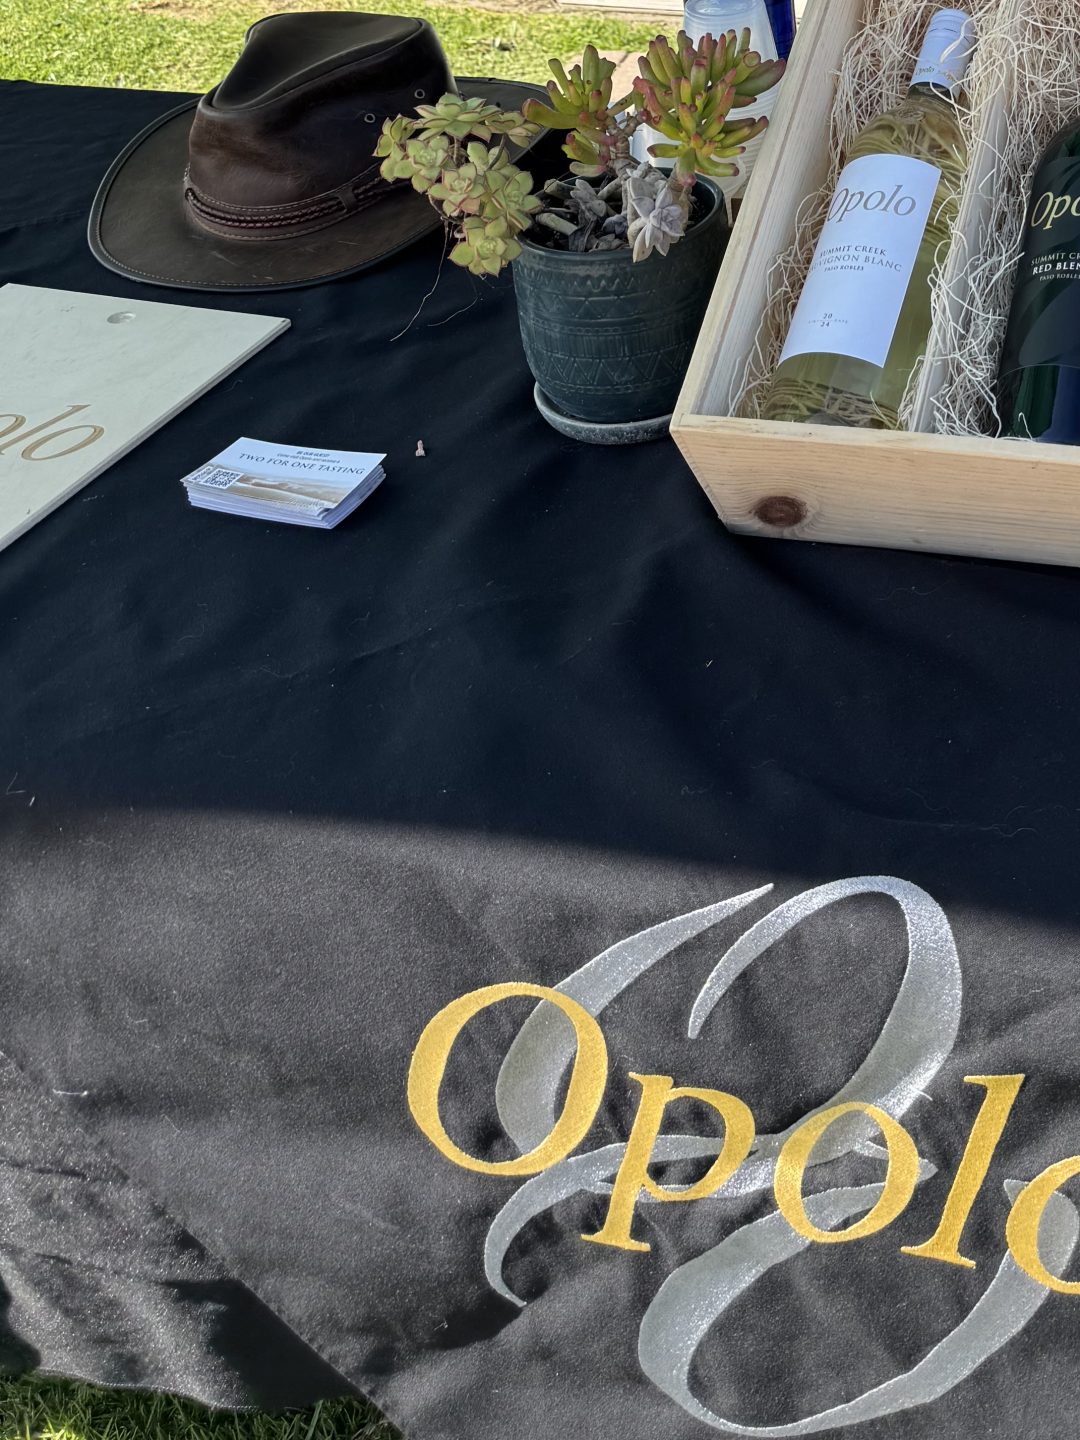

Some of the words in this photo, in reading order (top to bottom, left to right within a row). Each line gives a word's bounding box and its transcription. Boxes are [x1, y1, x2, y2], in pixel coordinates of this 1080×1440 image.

[826, 184, 917, 224] Opolo
[820, 245, 852, 258] SUMMIT
[854, 245, 887, 257] CREEK
[1031, 252, 1066, 266] SUMMIT
[864, 255, 903, 273] BLANC
[1032, 263, 1052, 275] RED
[239, 453, 265, 463] TWO
[266, 458, 289, 467] FOR
[291, 462, 316, 470] ONE
[318, 465, 365, 475] TASTING
